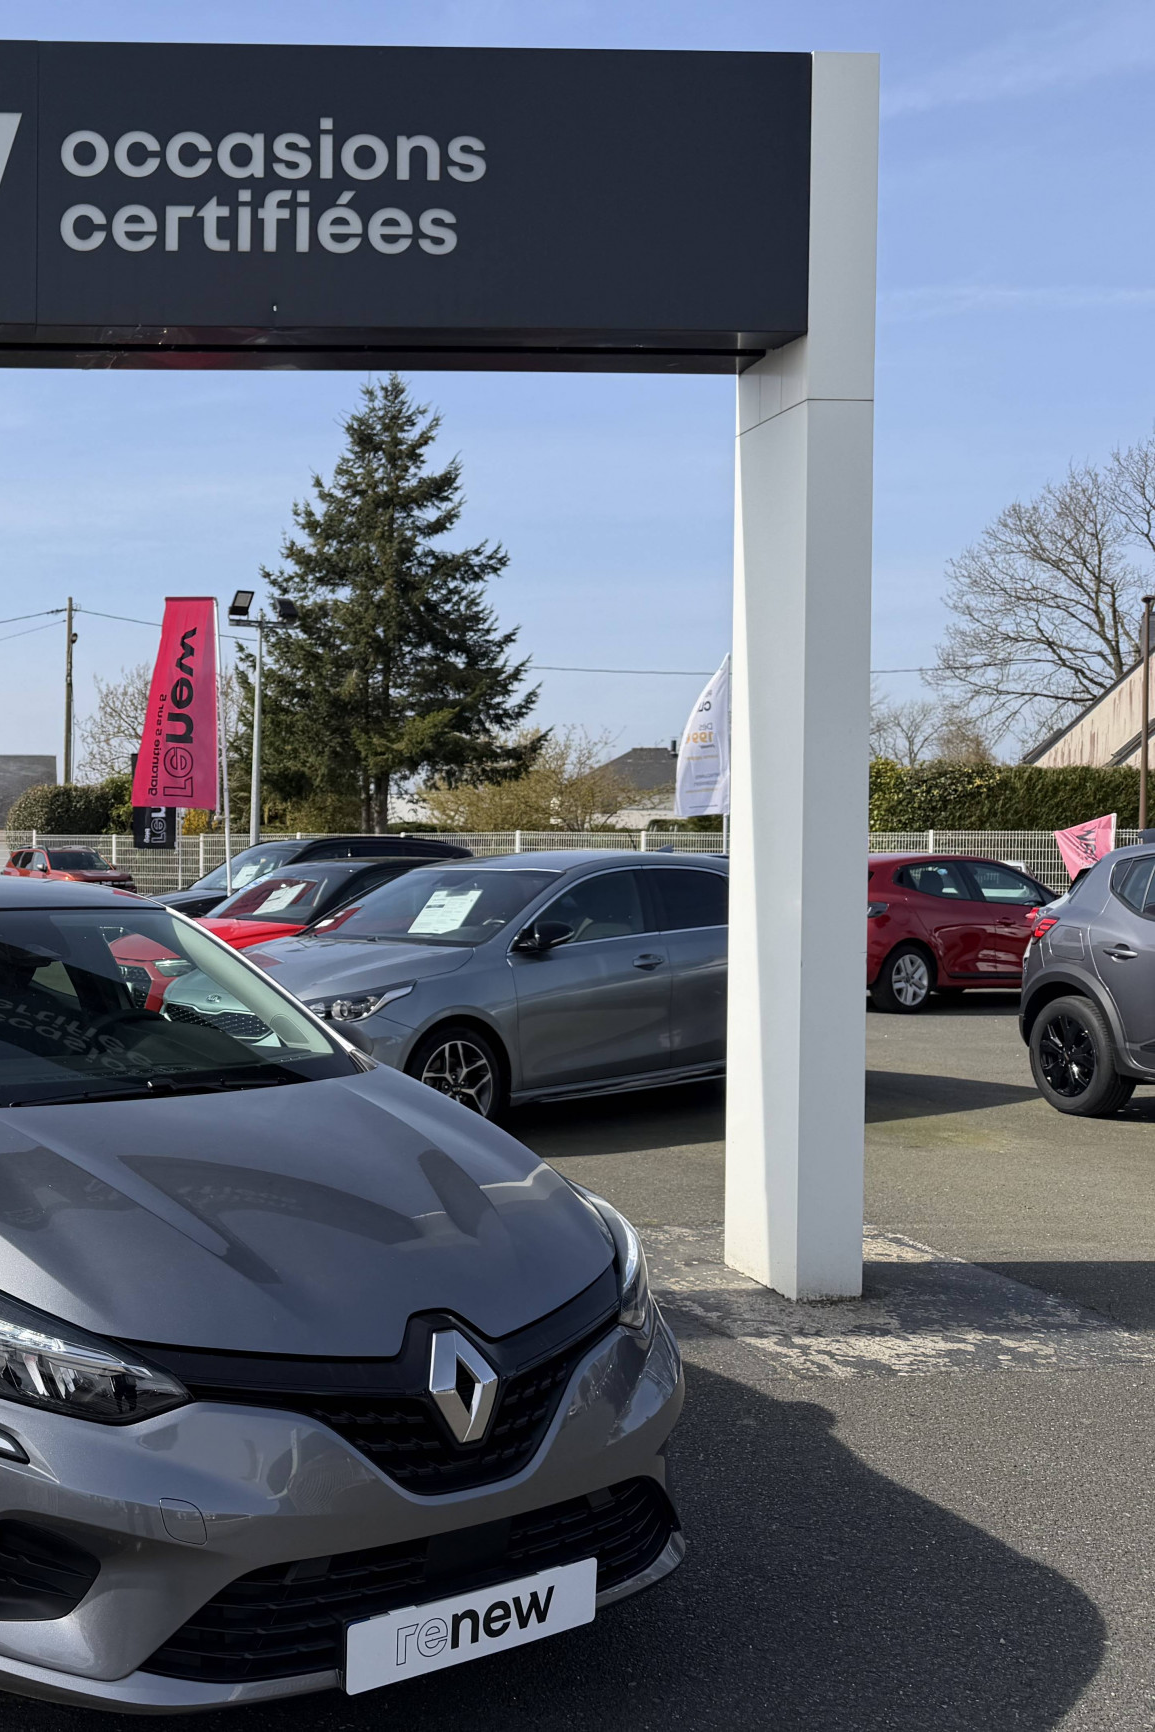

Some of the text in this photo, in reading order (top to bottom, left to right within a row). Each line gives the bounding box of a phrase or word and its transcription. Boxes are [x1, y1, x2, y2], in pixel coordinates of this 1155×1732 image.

[60, 117, 487, 182] occasions
[60, 189, 458, 256] certifiées
[396, 1585, 555, 1666] renew
